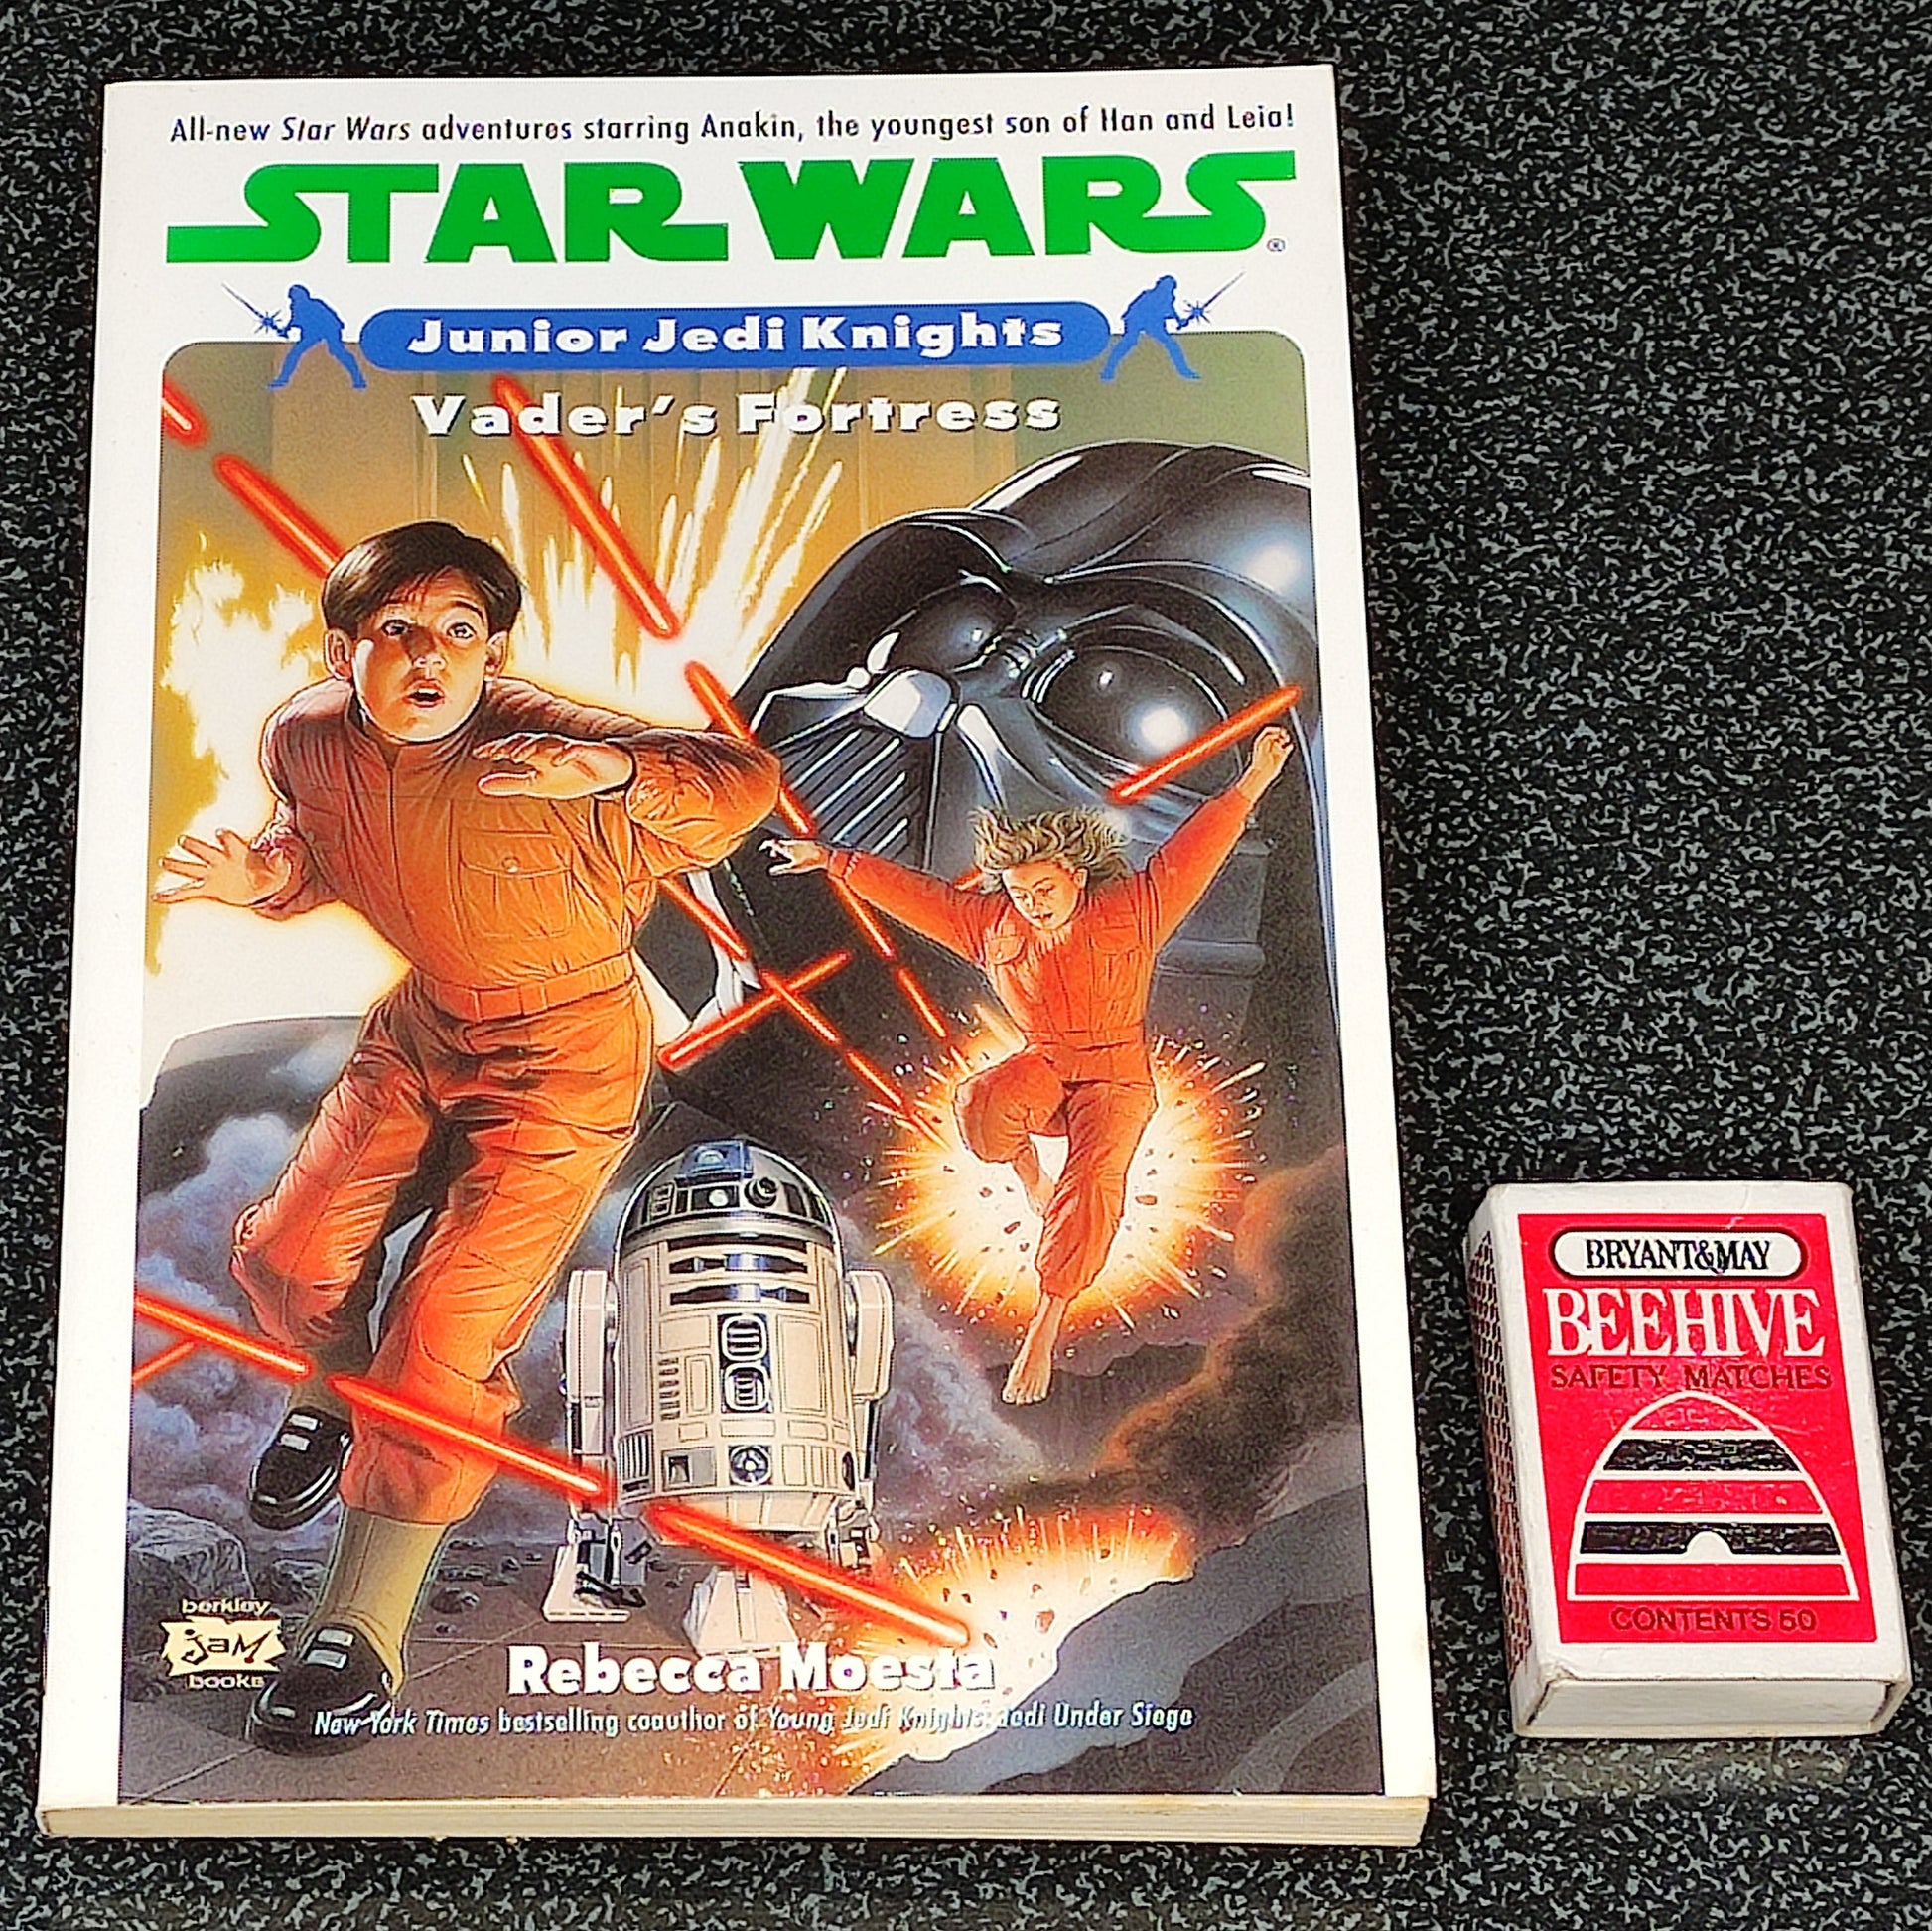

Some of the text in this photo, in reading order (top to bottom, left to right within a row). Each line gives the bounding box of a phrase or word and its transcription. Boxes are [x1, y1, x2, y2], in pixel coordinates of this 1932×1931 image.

[170, 103, 1295, 143] All-new Star Wars adventures starring Anakin, the youngest son of Han and Leia!
[166, 150, 1296, 264] STAR WARS
[407, 313, 1064, 359] Junior Jedi Knights
[737, 393, 1062, 435] Fortress
[1586, 1238, 1772, 1275] BRYANT&MAY
[1543, 1288, 1827, 1357] BEEHIVE
[1551, 1366, 1832, 1389] SAFETY MATCHES
[1611, 1607, 1817, 1631] CONTENTS 50
[189, 1674, 265, 1688] books
[506, 1642, 997, 1694] Rebecca Moesta
[314, 1710, 361, 1735] New
[370, 1706, 417, 1735] York
[425, 1709, 490, 1734] Times
[498, 1705, 619, 1736] bestselling
[628, 1705, 726, 1731] coauthor
[734, 1703, 758, 1730] of
[768, 1704, 834, 1734] Young
[842, 1703, 890, 1733] Jedi
[1054, 1700, 1123, 1728] Under
[1130, 1700, 1194, 1730] Siege
